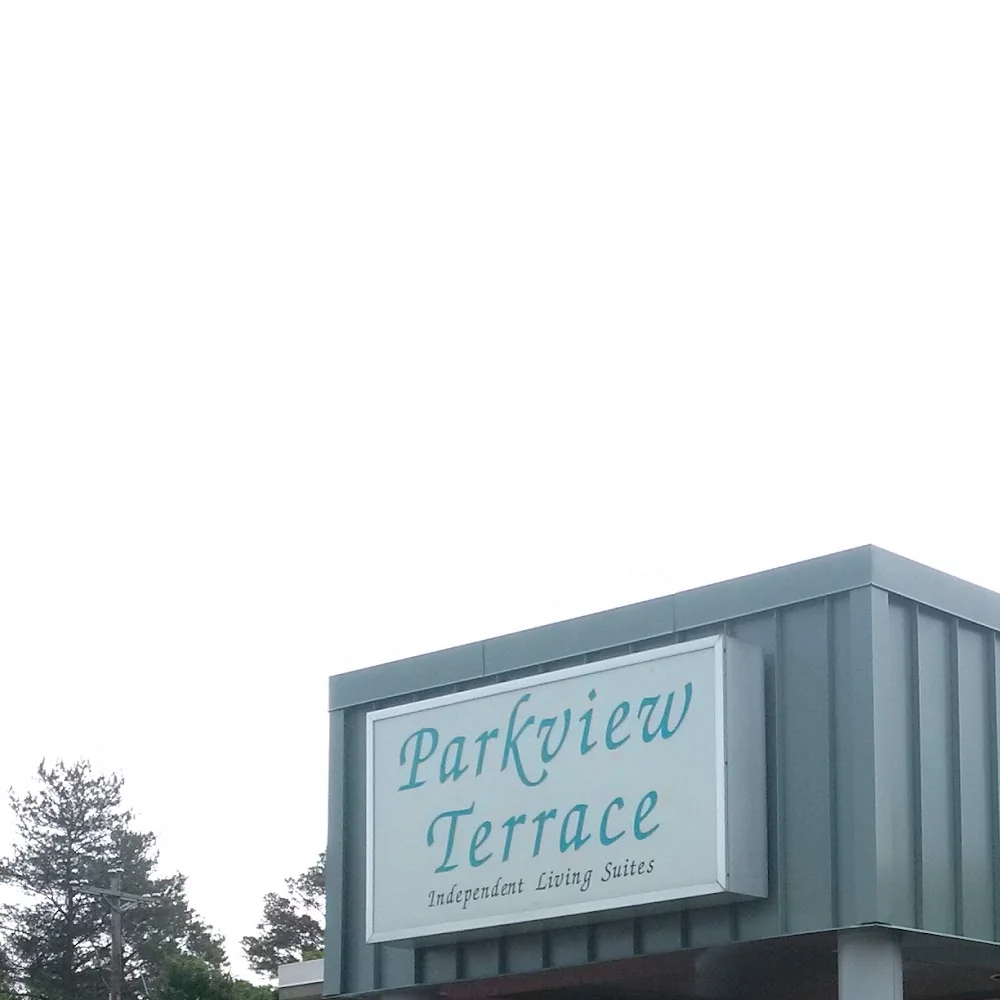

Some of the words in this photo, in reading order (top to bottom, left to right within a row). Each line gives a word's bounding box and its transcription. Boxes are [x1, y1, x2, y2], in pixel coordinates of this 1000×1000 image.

[397, 682, 692, 791] Parkview
[427, 790, 659, 874] Terrace
[428, 877, 524, 909] Independent
[535, 868, 593, 892] Living
[601, 859, 654, 882] Suites
